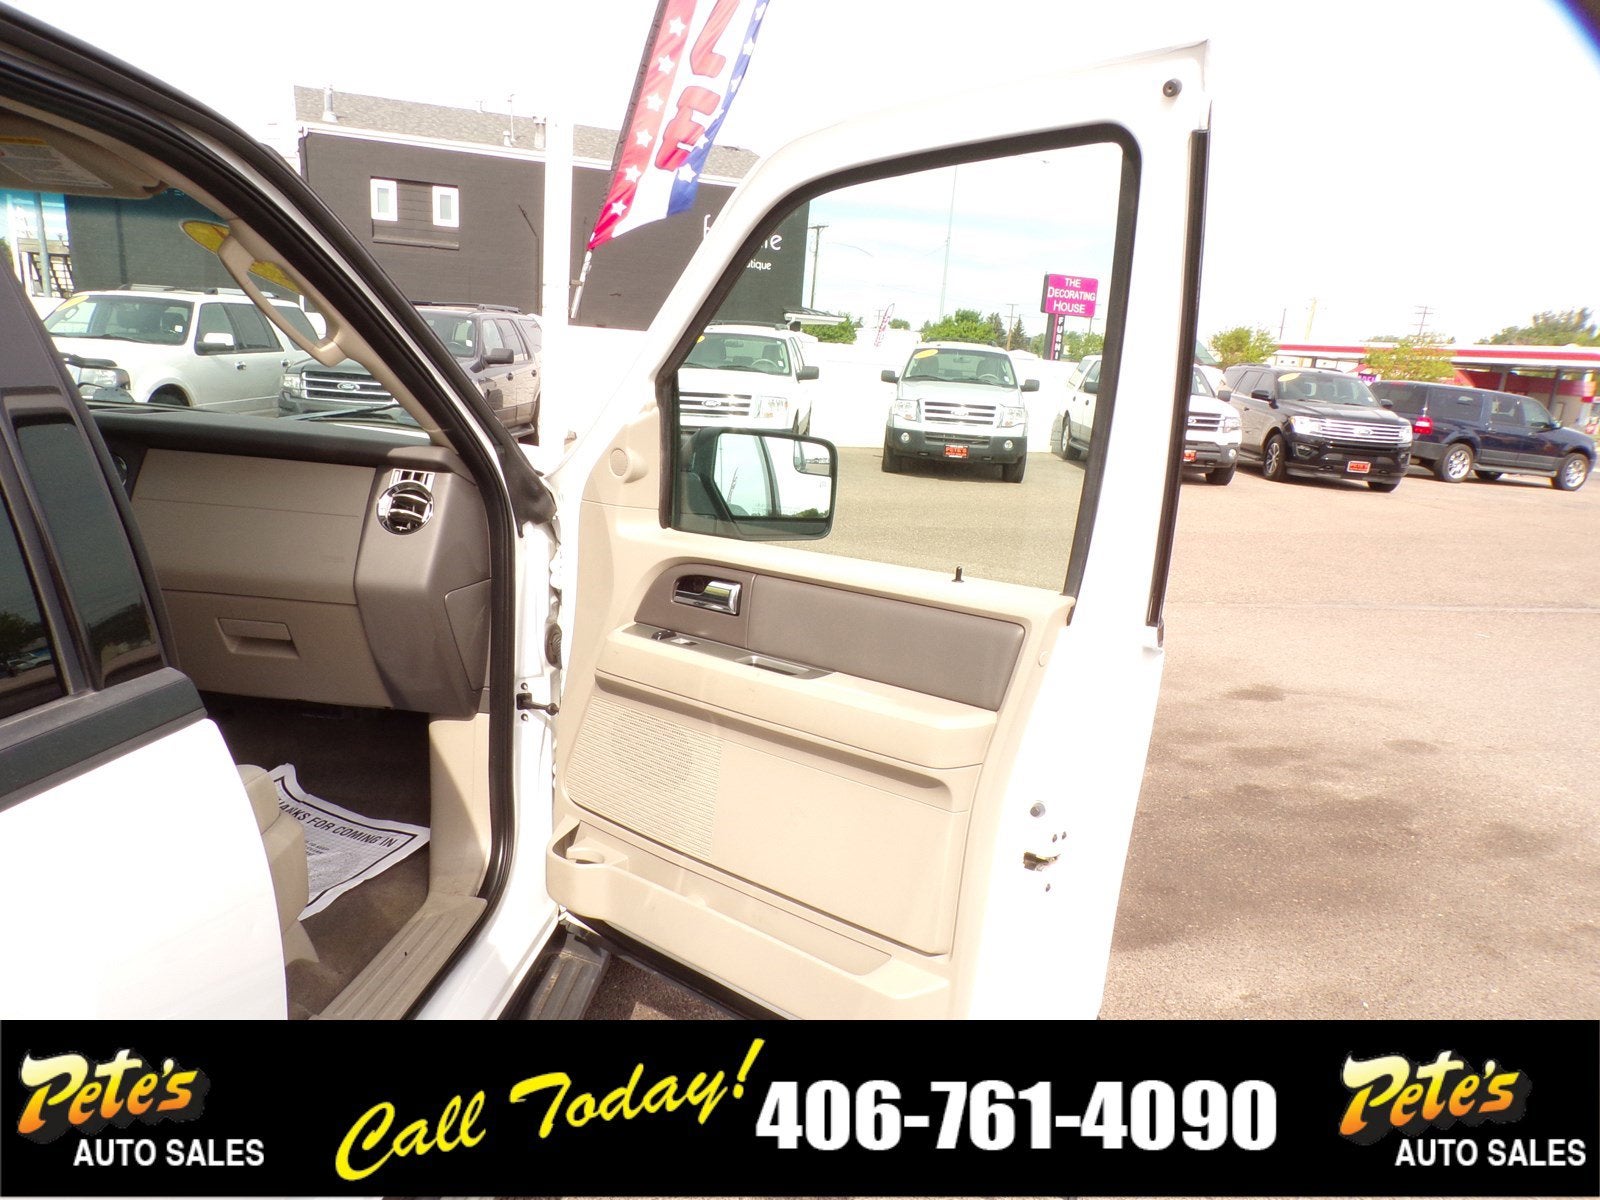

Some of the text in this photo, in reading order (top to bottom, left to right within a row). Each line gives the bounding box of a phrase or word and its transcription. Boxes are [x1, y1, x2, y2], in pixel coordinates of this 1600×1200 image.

[1065, 277, 1082, 288] THE
[1047, 286, 1096, 301] DECORATING
[1053, 299, 1086, 314] HOUSE
[307, 816, 335, 831] FOR
[332, 825, 382, 844] COMING
[379, 837, 399, 848] IN
